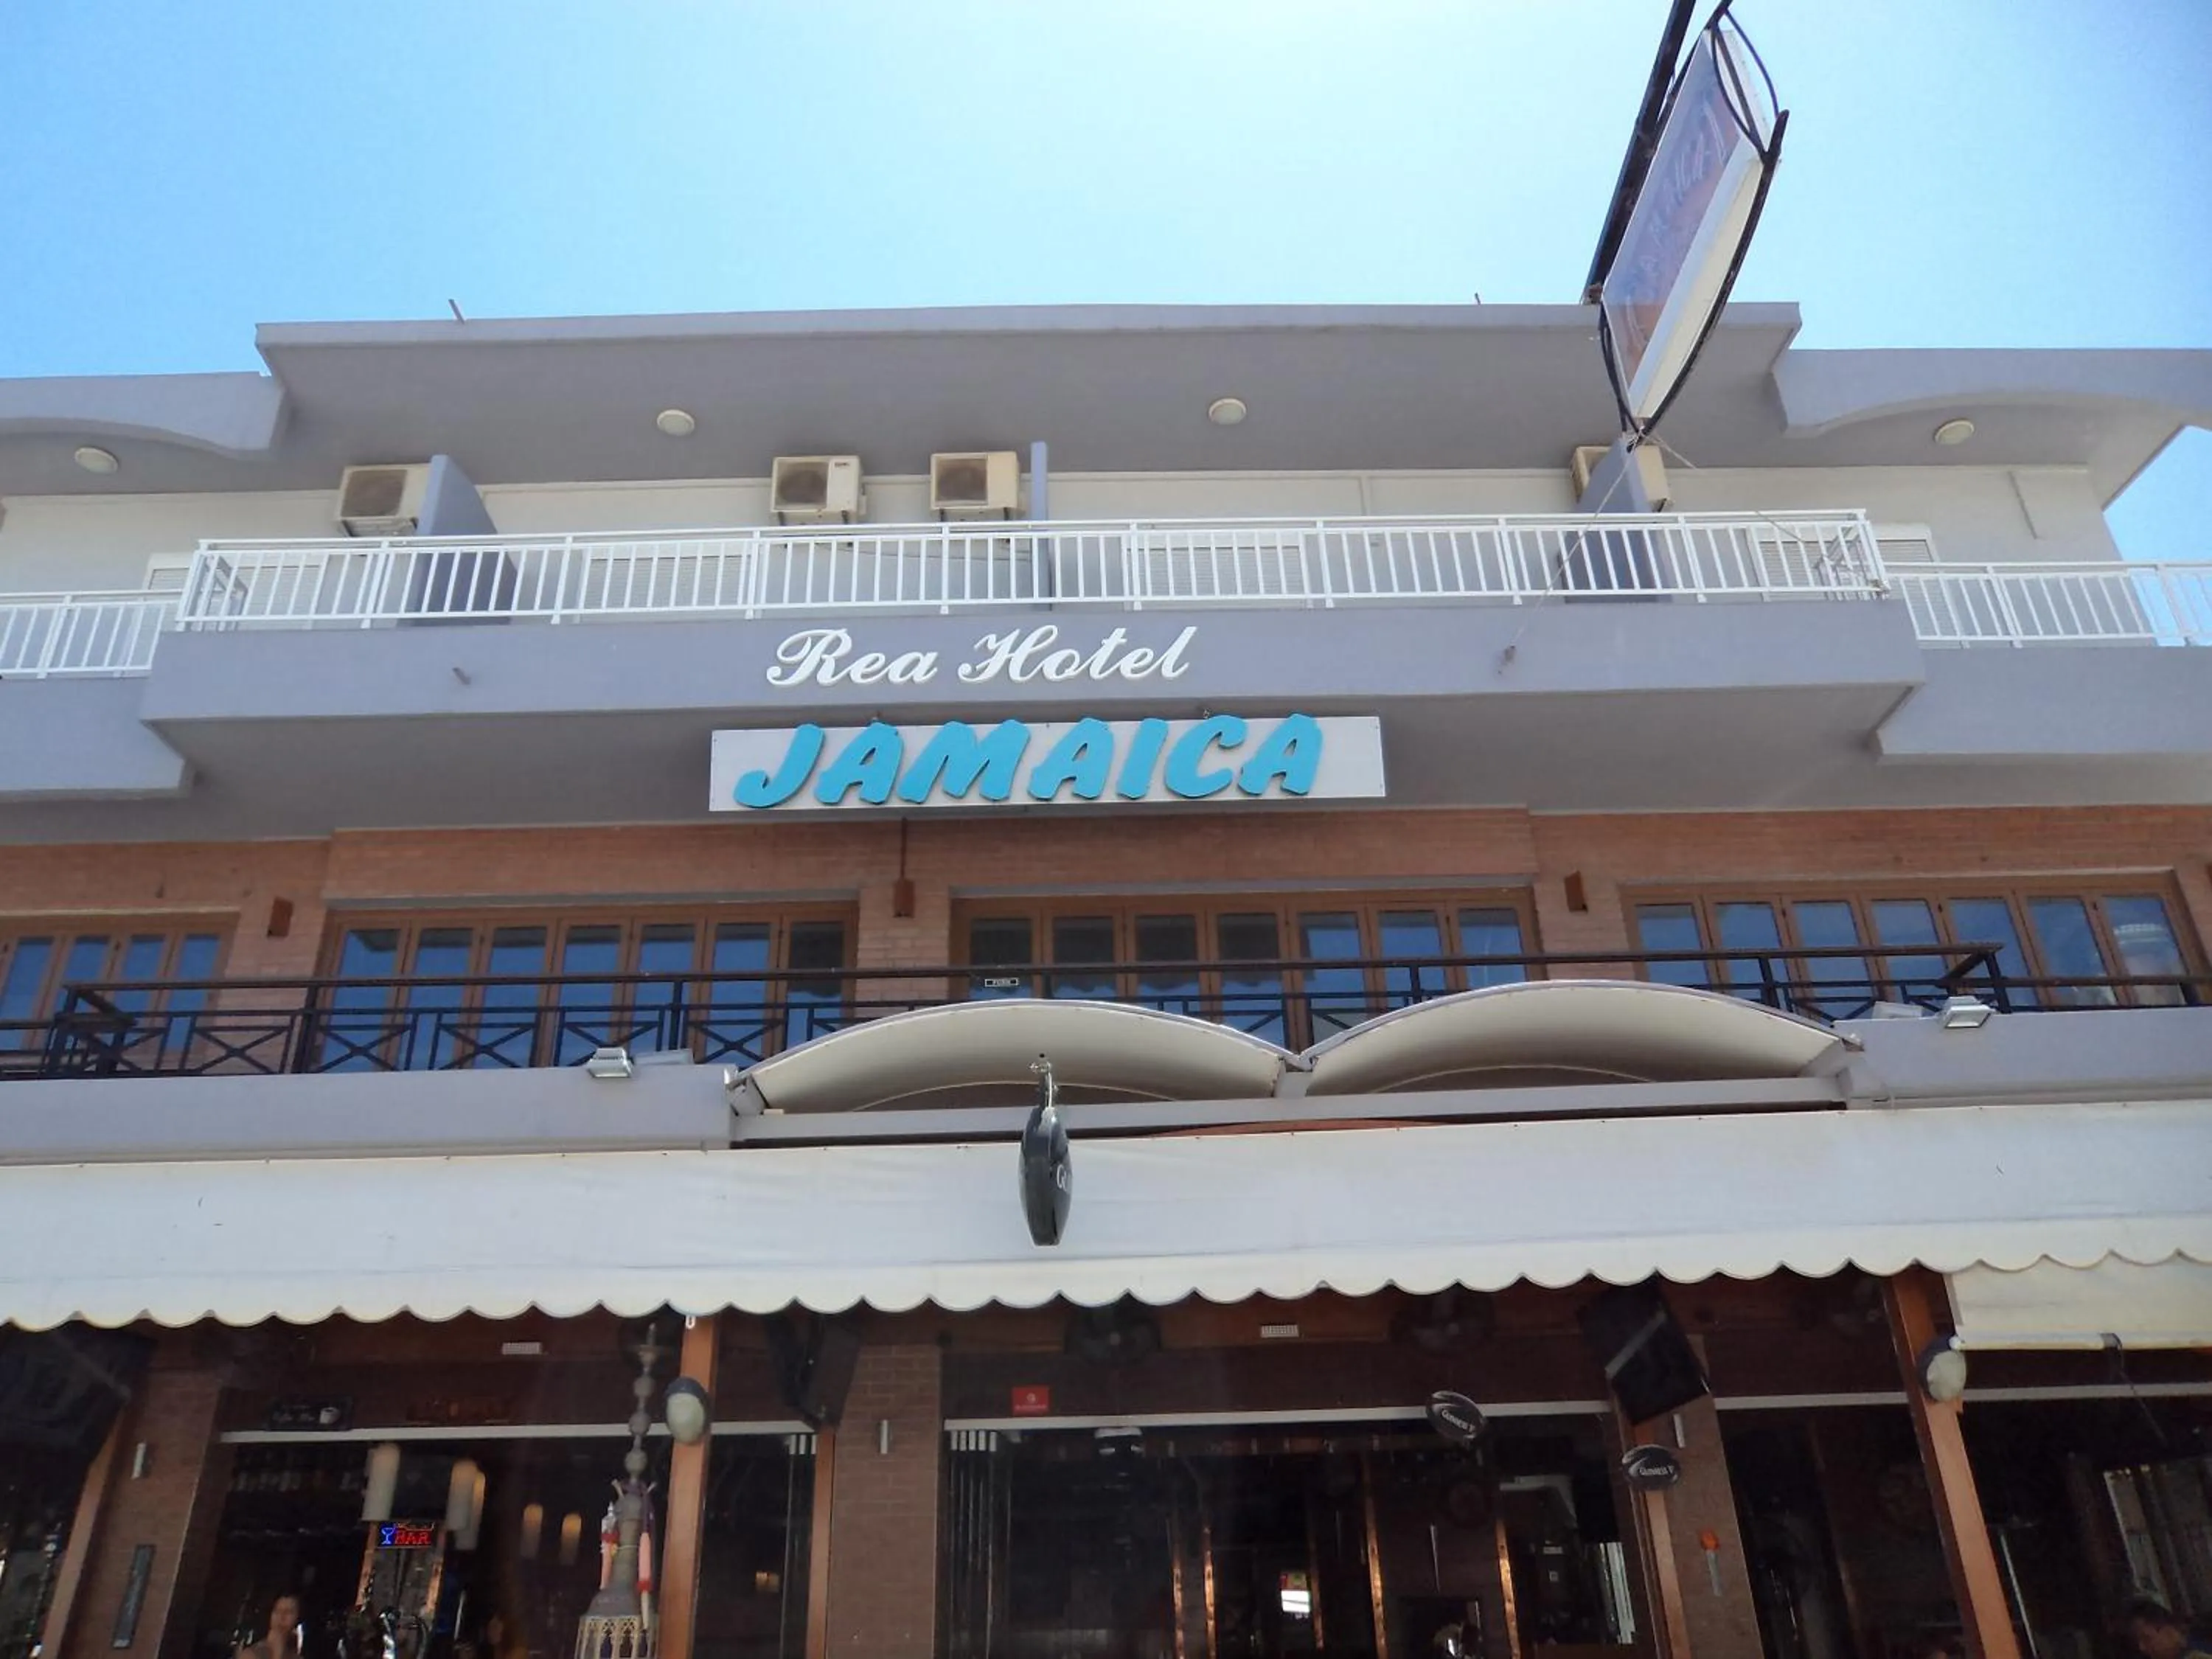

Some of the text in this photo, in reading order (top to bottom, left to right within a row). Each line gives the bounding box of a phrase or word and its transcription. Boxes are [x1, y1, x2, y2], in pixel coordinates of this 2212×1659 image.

[767, 625, 1198, 686] Rea Hotel
[733, 713, 1324, 808] JAMAICA
[394, 1530, 430, 1545] BAR
